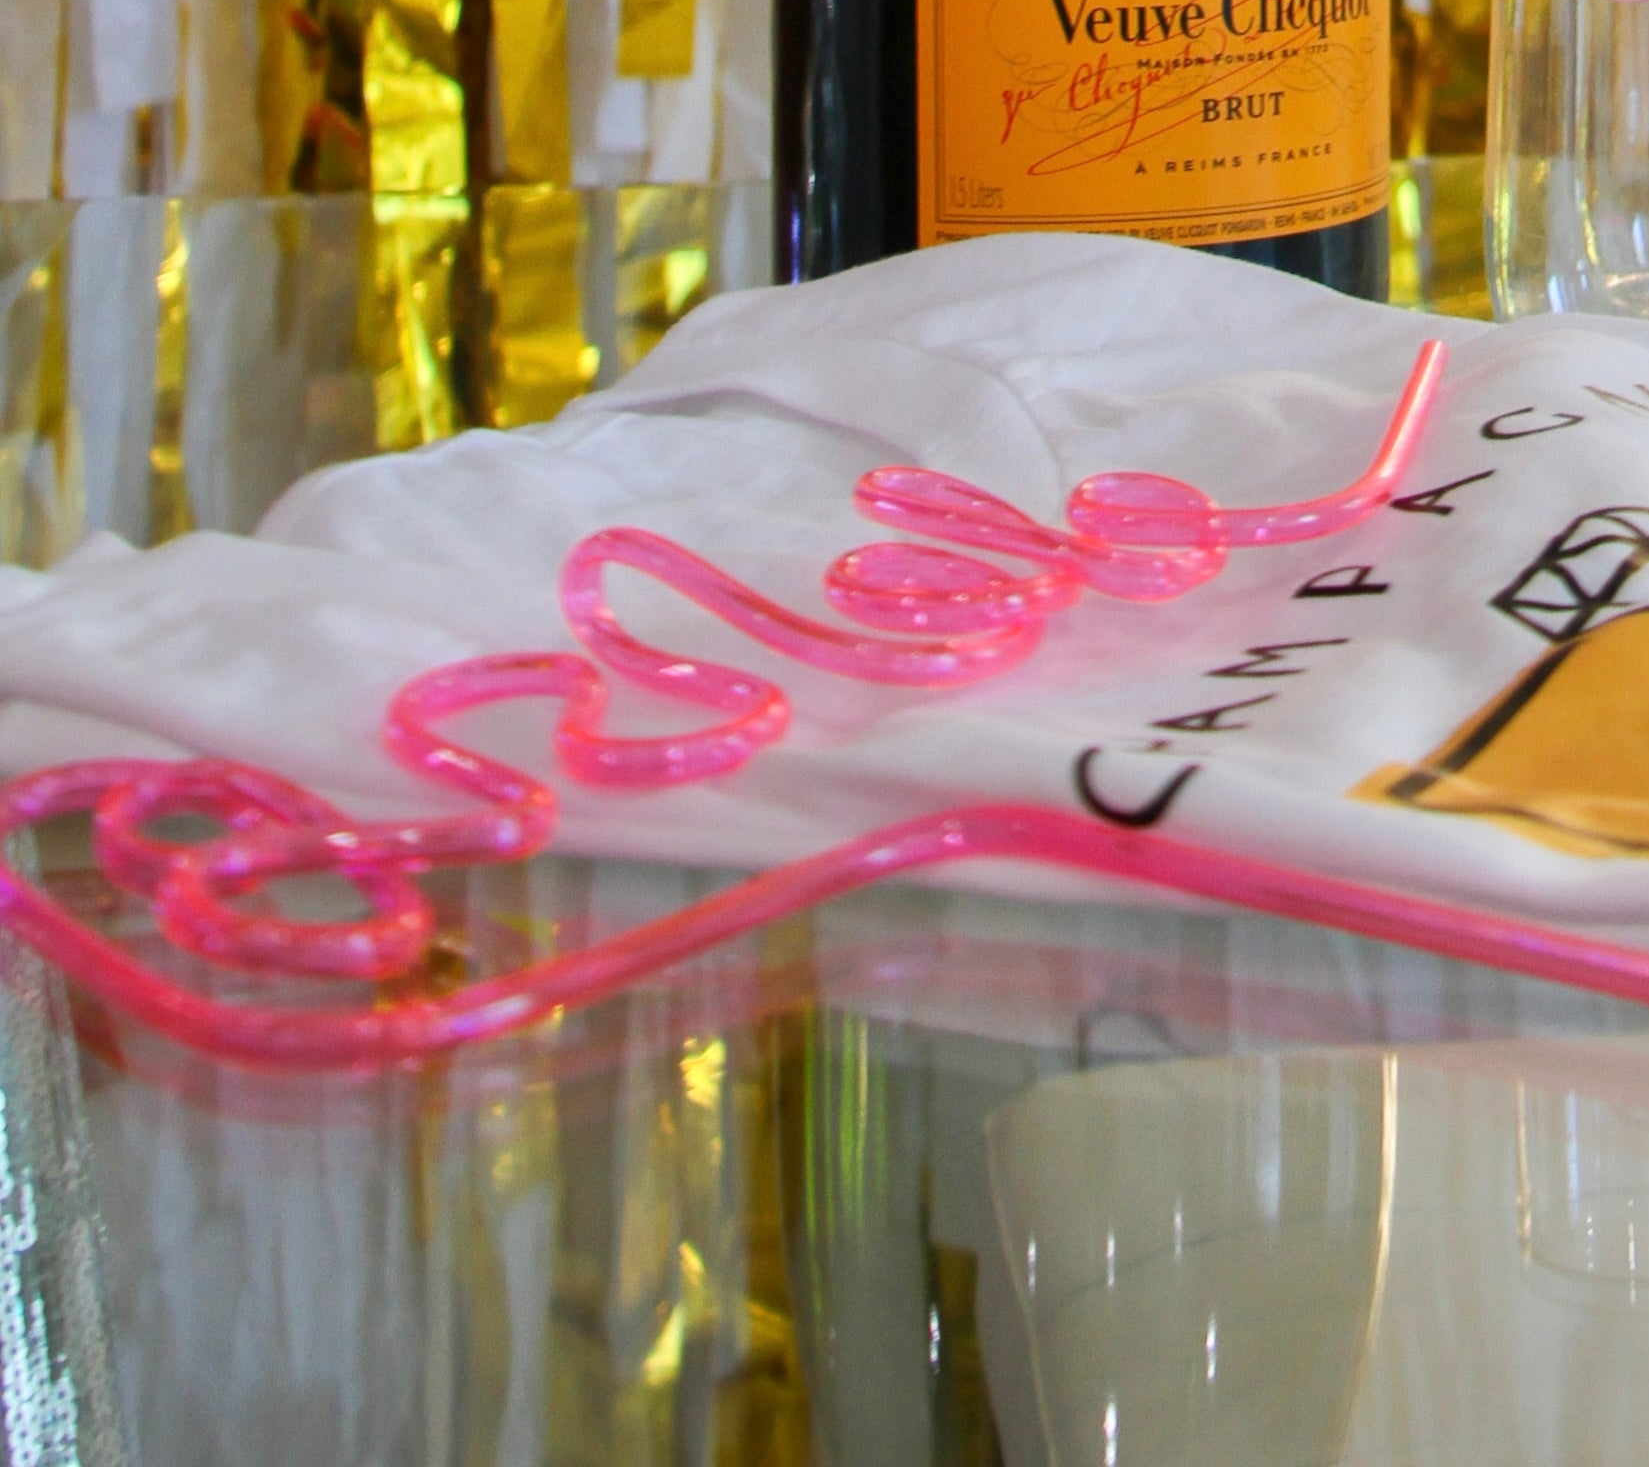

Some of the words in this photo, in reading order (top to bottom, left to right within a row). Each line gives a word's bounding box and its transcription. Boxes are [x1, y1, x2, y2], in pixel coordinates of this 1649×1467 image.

[1201, 91, 1286, 123] BRUT
[1164, 156, 1243, 173] REIMS
[1257, 142, 1333, 166] FRANCE
